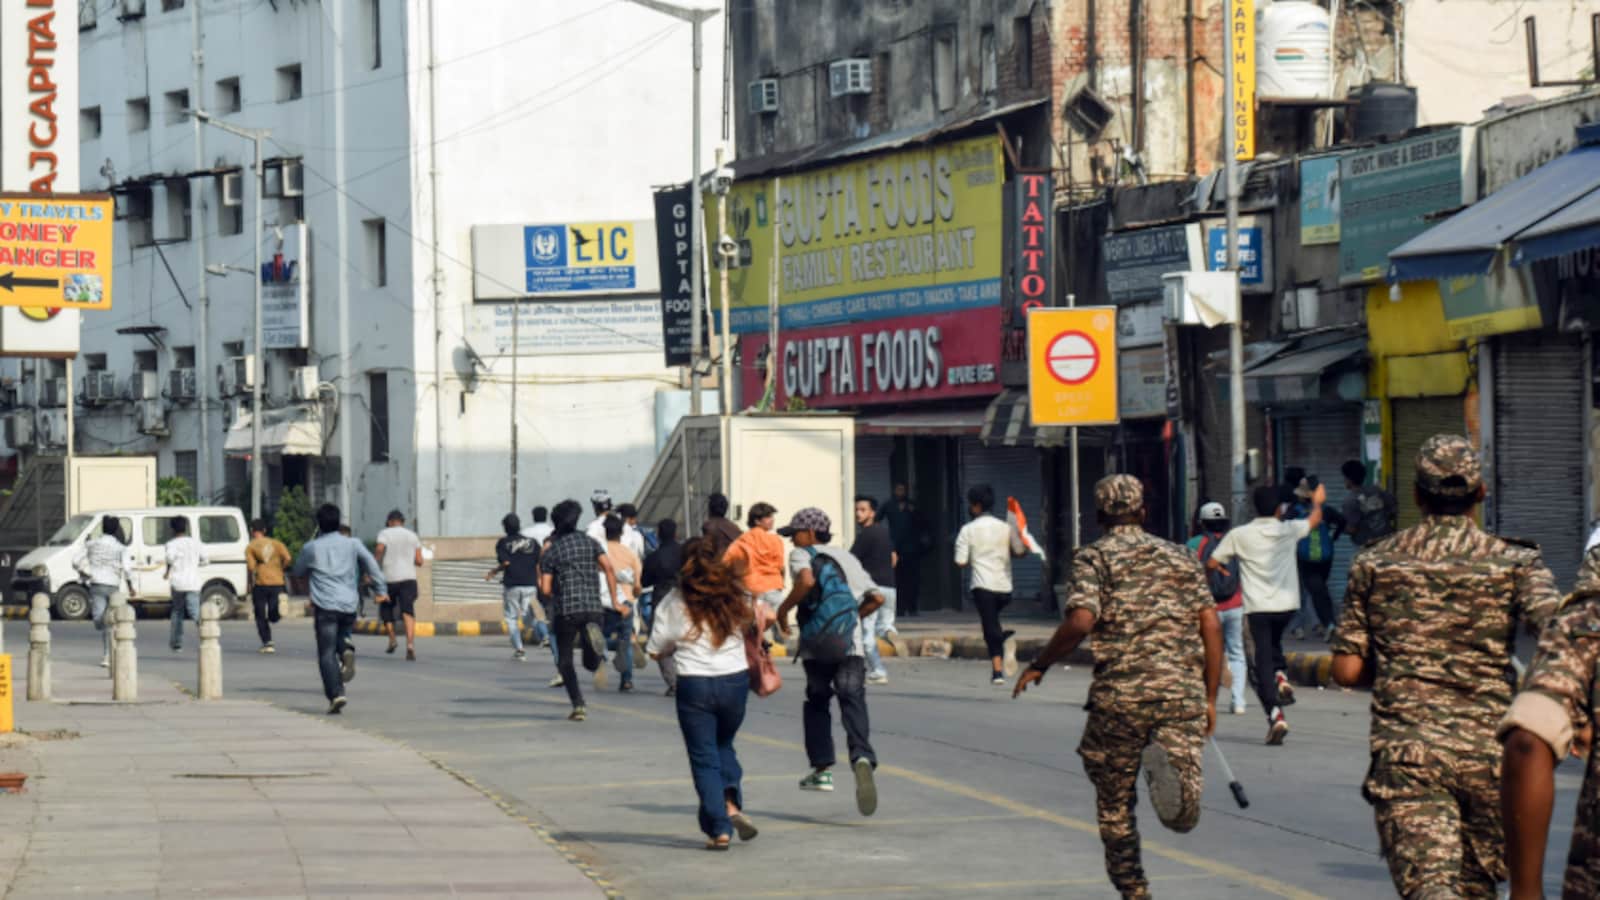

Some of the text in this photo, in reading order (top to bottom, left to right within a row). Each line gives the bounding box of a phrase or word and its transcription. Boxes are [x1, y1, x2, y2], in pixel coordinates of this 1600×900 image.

[1236, 72, 1247, 155] LINGUA
[1410, 142, 1433, 162] BEER
[1436, 135, 1460, 157] SHOP
[20, 204, 104, 220] TRAVELS
[780, 155, 955, 248] GUPTA FOODS
[0, 222, 77, 243] ONEY
[0, 247, 96, 269] ANGER
[574, 226, 628, 262] LIC
[672, 204, 691, 294] GUPTA
[782, 227, 976, 294] FAMILY RESTAURANT
[783, 335, 857, 398] GUPTA
[861, 326, 940, 392] FOODS
